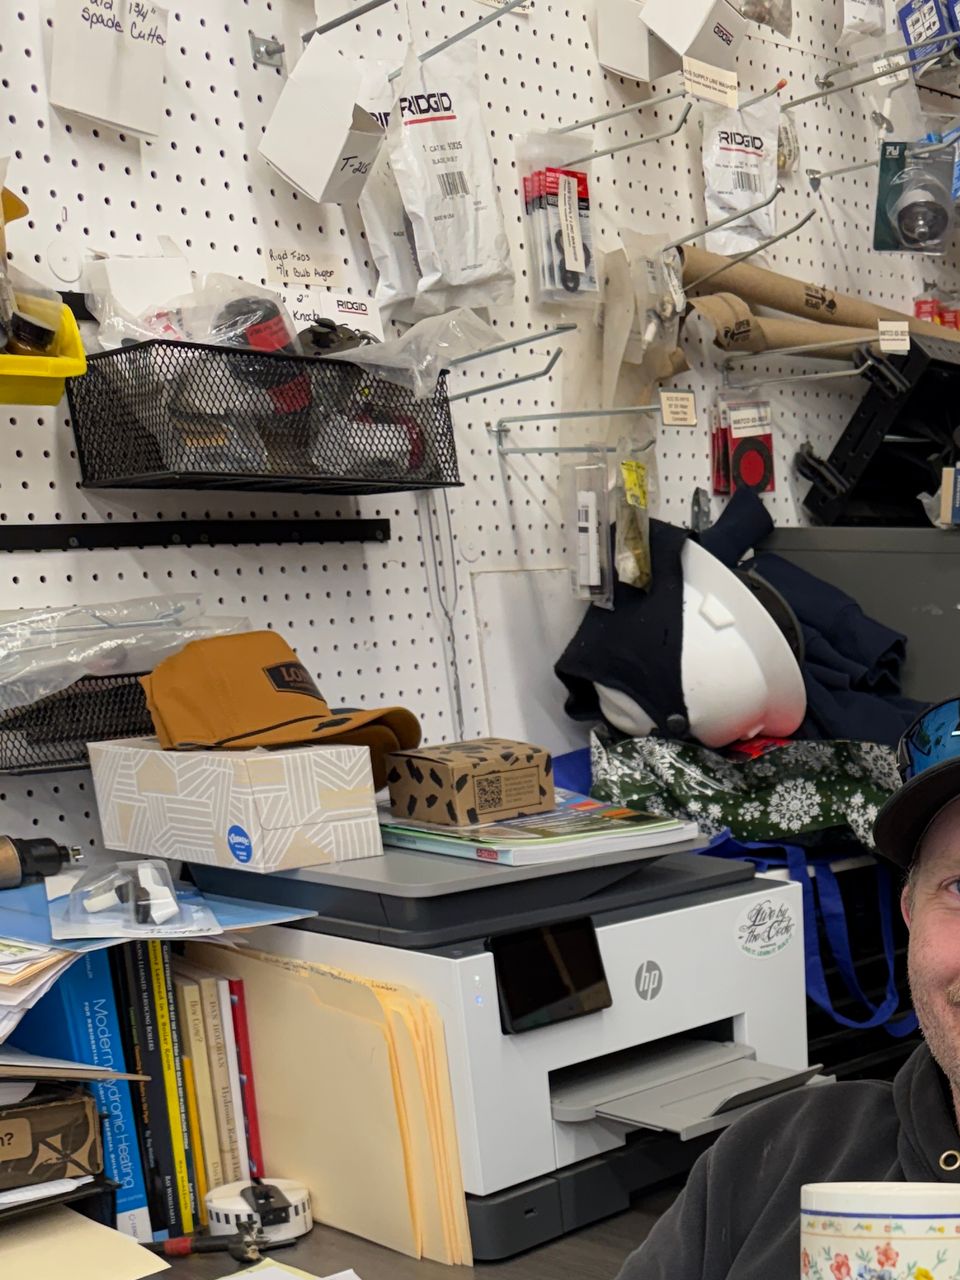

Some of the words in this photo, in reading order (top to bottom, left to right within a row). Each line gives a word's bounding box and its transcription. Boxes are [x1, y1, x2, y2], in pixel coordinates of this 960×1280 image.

[81, 7, 124, 33] Spade
[713, 25, 733, 46] RIDGID
[399, 92, 454, 118] RIDGID
[718, 131, 764, 150] RIDGID
[293, 267, 311, 278] Bulb
[314, 268, 335, 282] Auger
[336, 300, 368, 312] RIDGID
[636, 960, 662, 1000] hp
[209, 1000, 218, 1018] DAN
[212, 1021, 225, 1068] HOLOHAN
[93, 999, 114, 1069] Modern
[104, 1076, 126, 1133] ydronic
[115, 1134, 136, 1190] Heating
